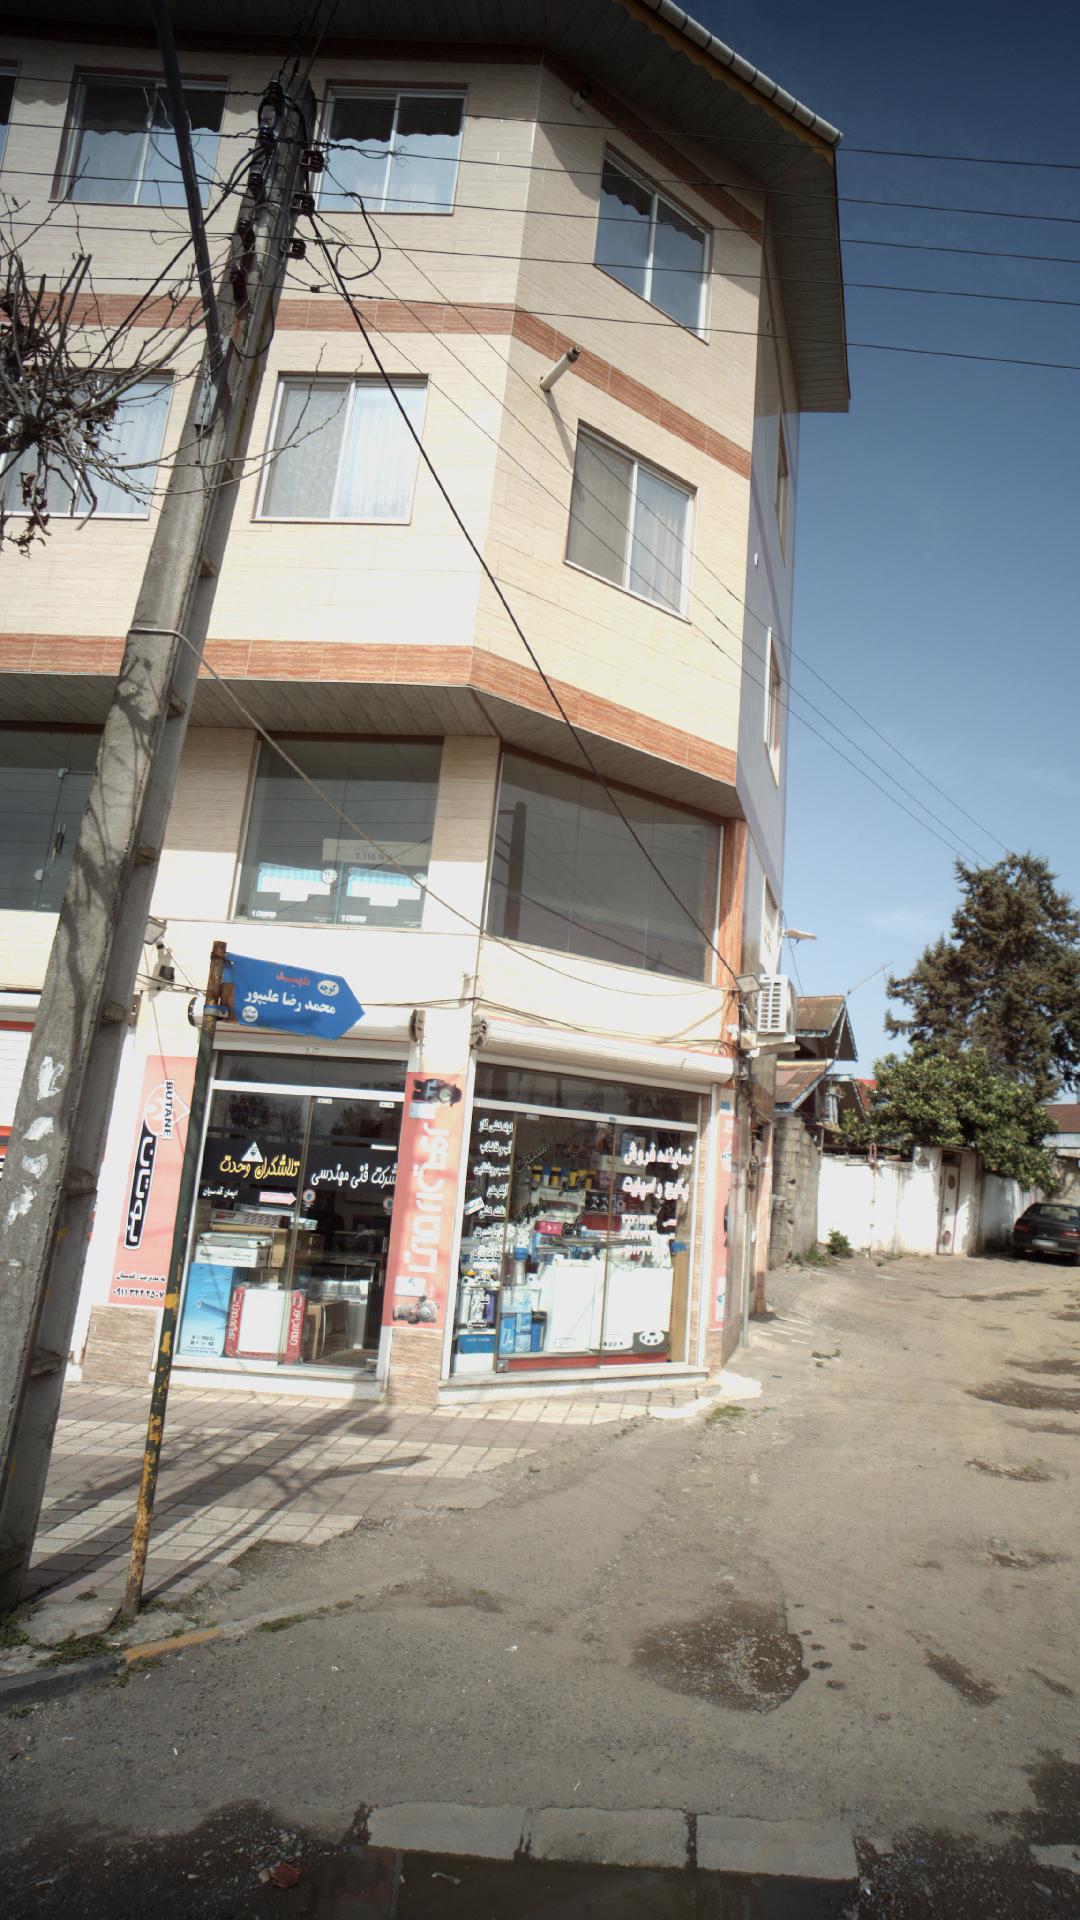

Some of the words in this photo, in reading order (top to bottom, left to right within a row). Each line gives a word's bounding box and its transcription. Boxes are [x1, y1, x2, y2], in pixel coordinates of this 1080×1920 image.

[243, 988, 279, 1006] علیپور
[319, 983, 337, 995] کوچه
[282, 992, 302, 1013] رضا
[305, 998, 336, 1015] محمد
[163, 1081, 174, 1137] BUTANE
[623, 1141, 657, 1166] فروش
[657, 1145, 693, 1170] نماینده
[219, 1154, 251, 1178] وحدت
[255, 1154, 301, 1180] تلاشگران
[311, 1163, 350, 1187] مهندسی
[350, 1163, 369, 1189] فنی
[372, 1161, 398, 1189] شرکت
[127, 1136, 155, 1243] بوتان
[202, 1186, 224, 1197] قدسیان
[223, 1188, 239, 1199] ایمان
[654, 1182, 663, 1199] و
[664, 1177, 690, 1203] پکیج
